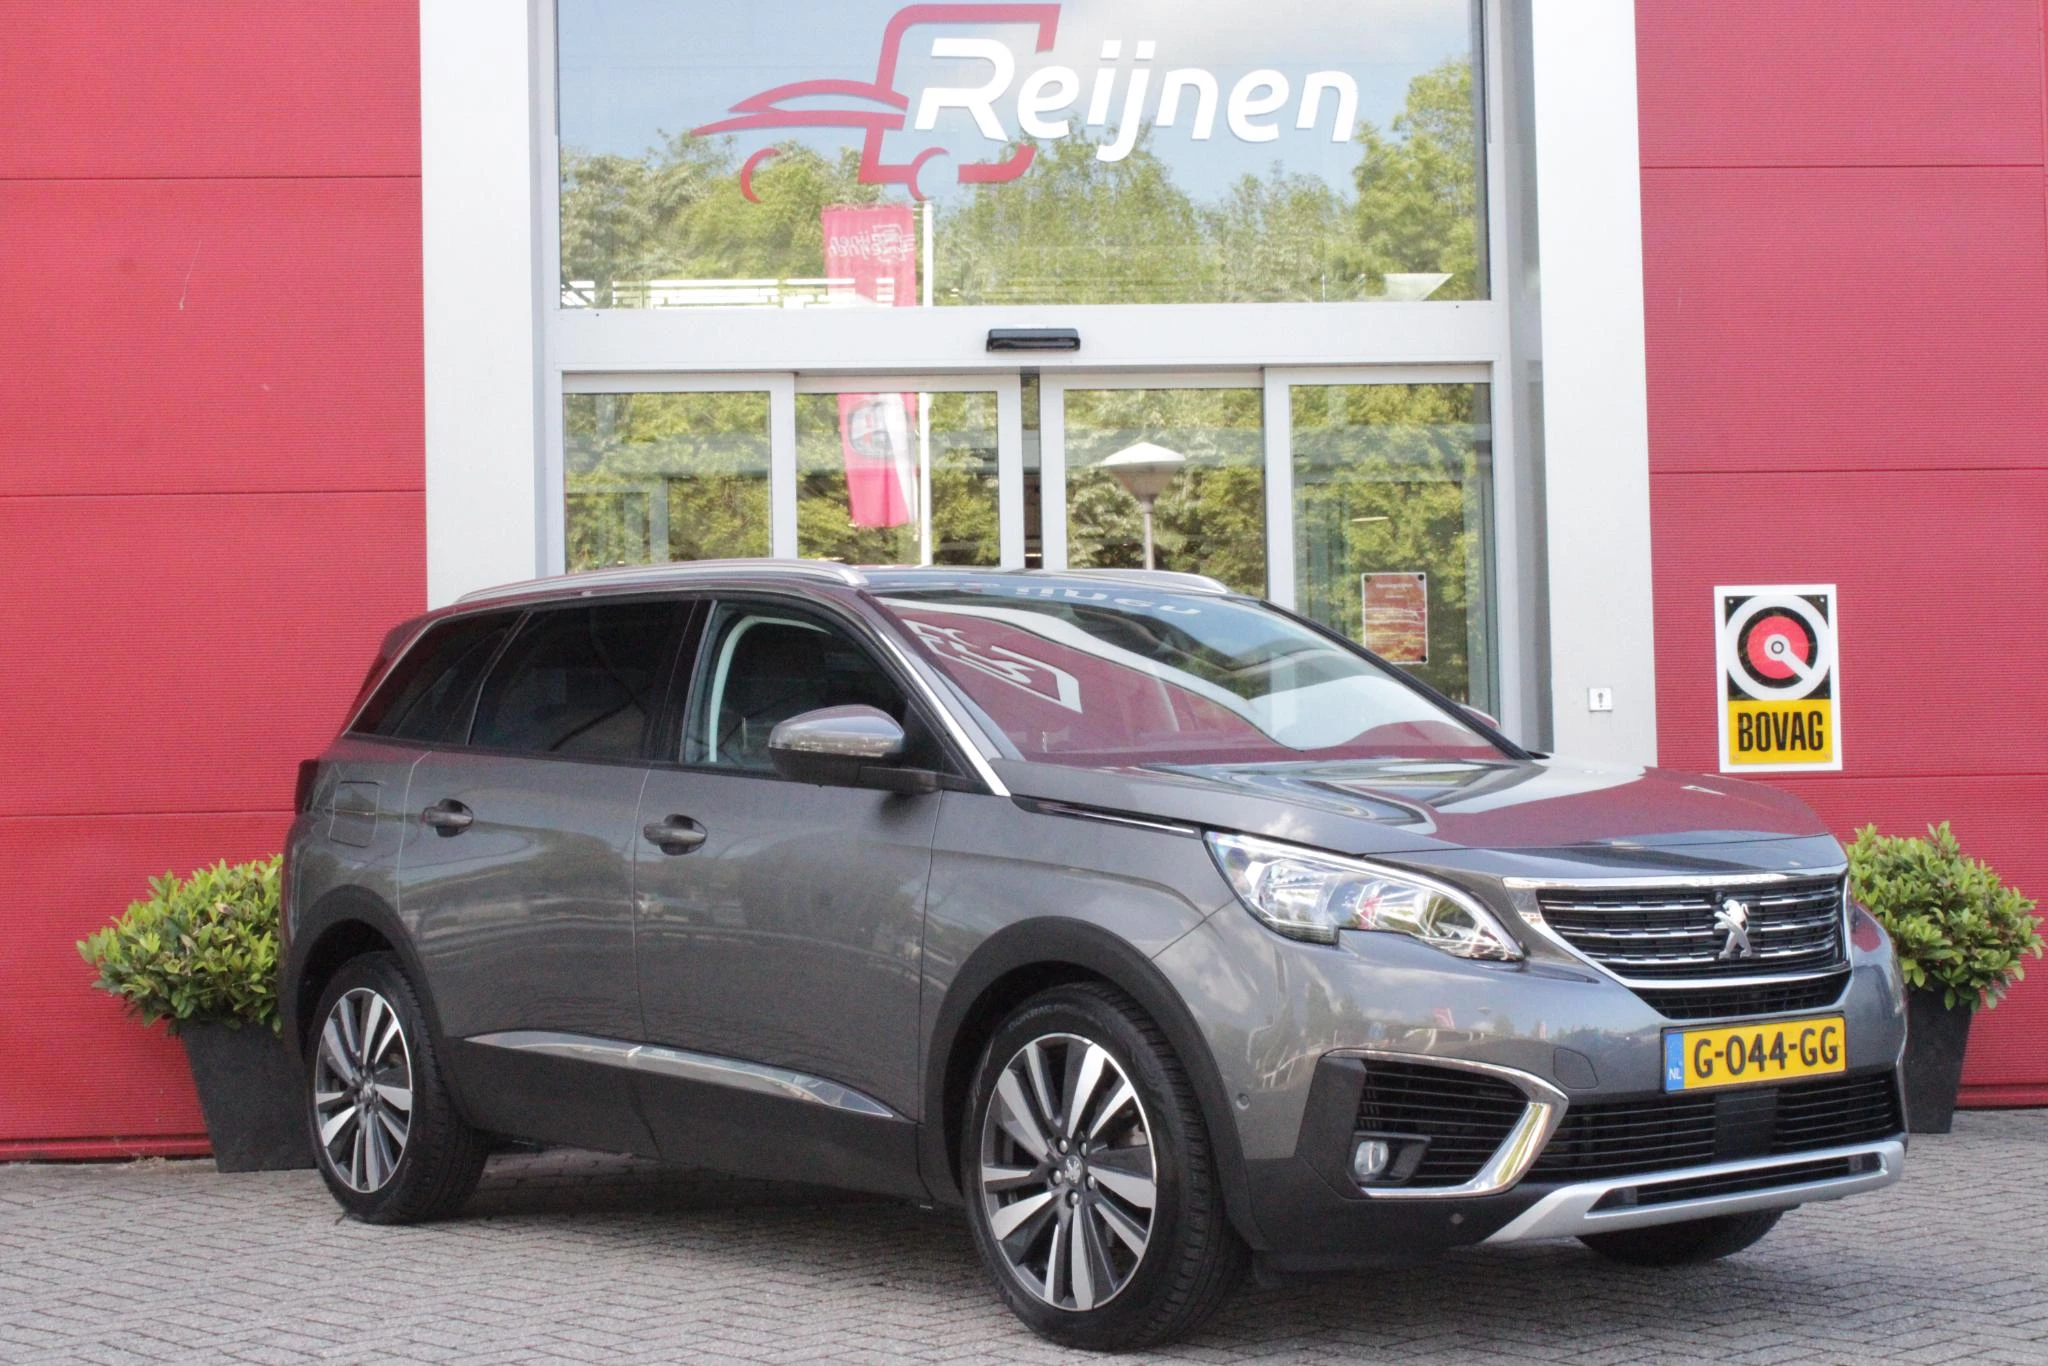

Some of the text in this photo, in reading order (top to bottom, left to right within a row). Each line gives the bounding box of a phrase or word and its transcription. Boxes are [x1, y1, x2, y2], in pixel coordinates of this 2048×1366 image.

[914, 38, 1359, 162] Reijnen
[1737, 711, 1824, 752] BOVAG
[1668, 1026, 1839, 1081] NL G-044-GG
